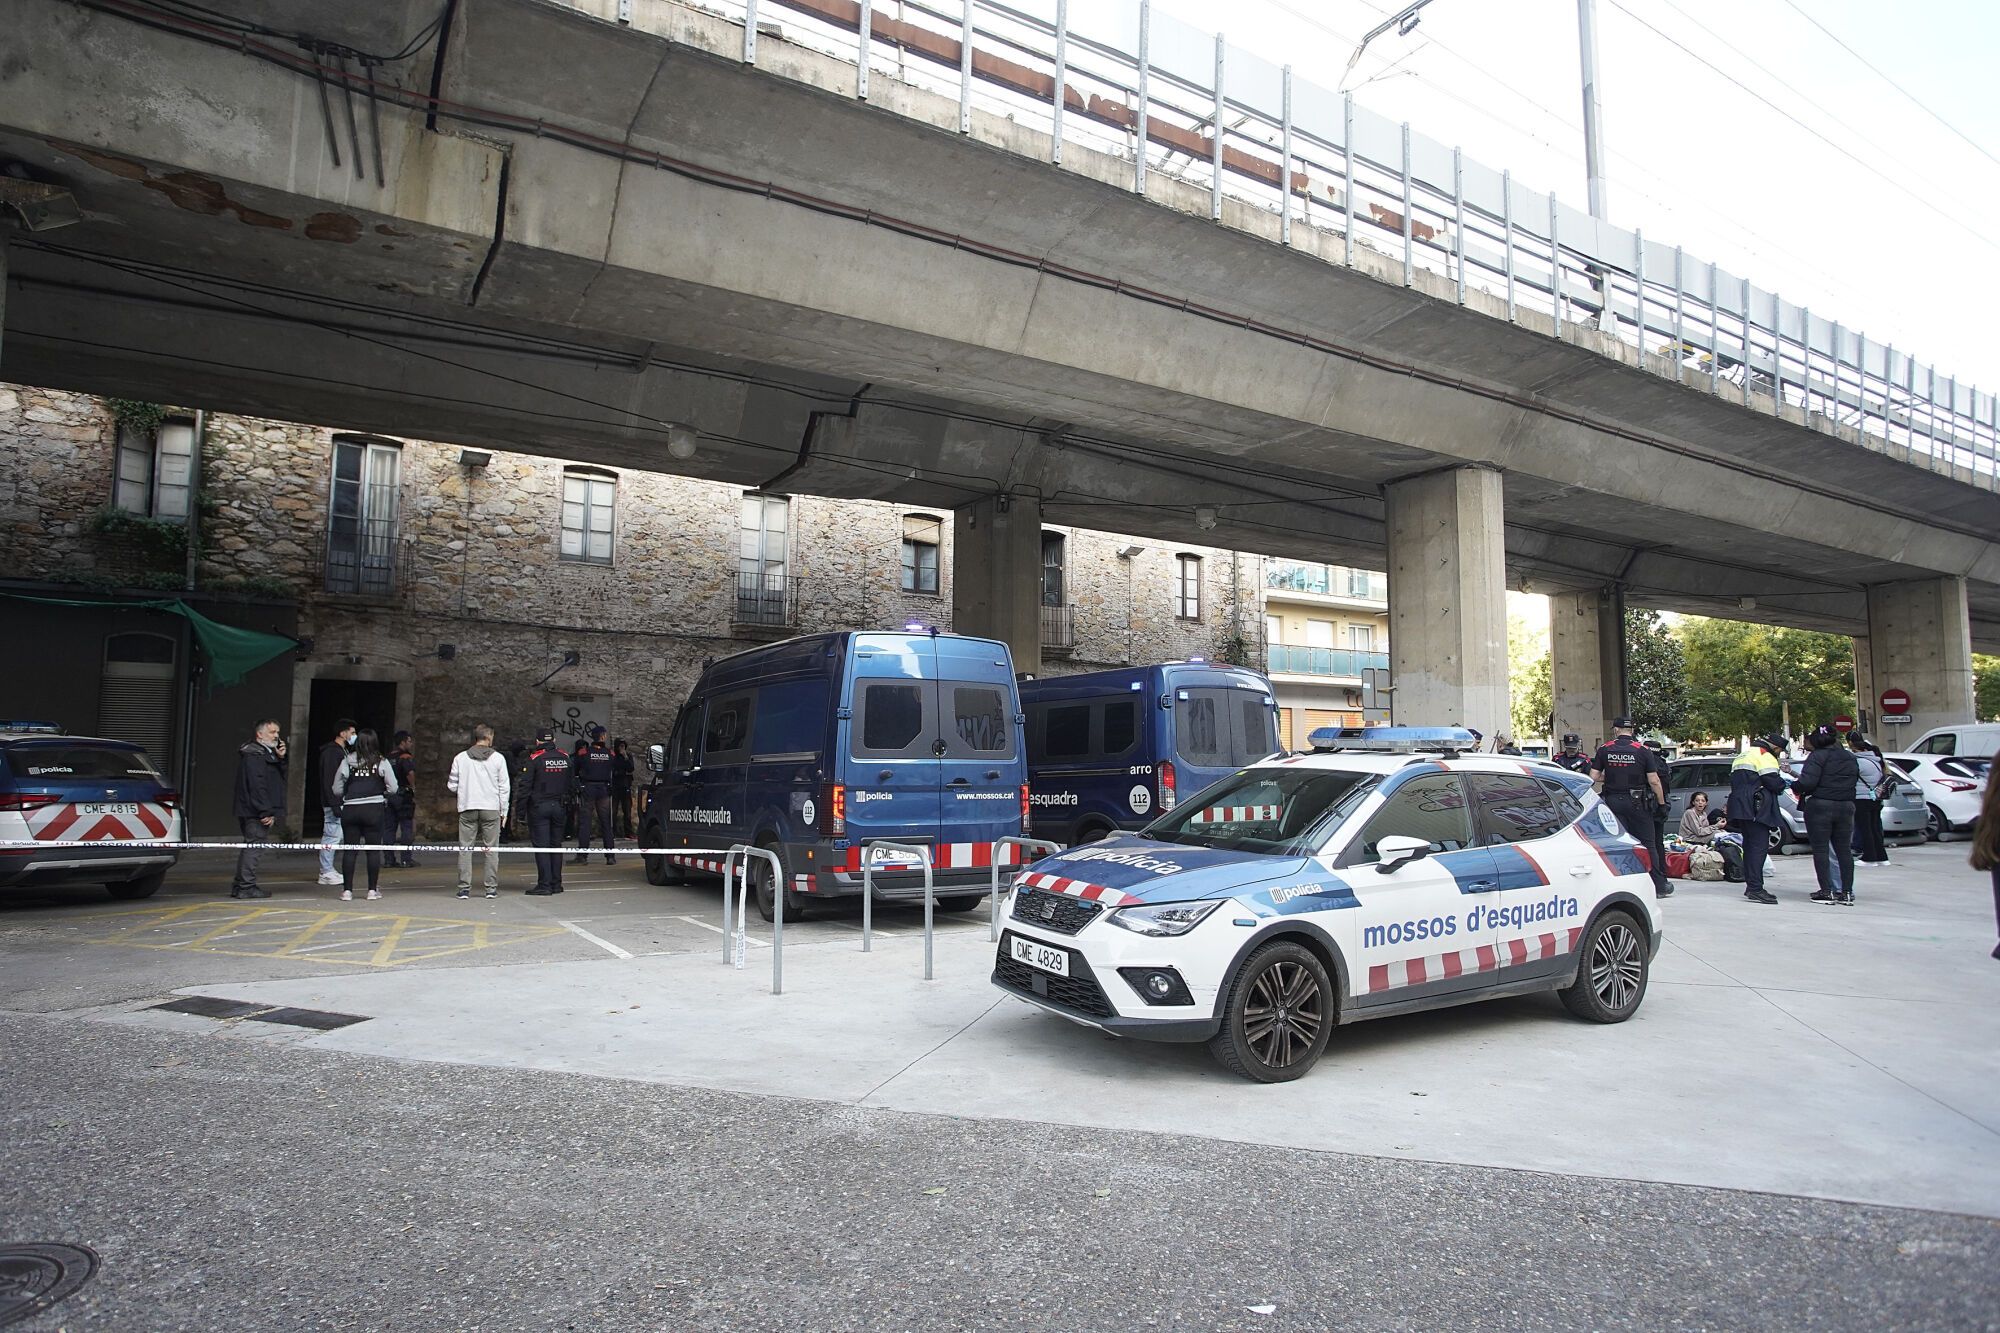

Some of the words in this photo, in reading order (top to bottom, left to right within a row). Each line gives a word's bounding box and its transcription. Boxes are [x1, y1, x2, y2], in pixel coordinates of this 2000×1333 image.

[40, 766, 73, 774] policia
[1130, 764, 1152, 775] arro
[866, 792, 892, 801] policia
[956, 791, 1014, 800] www.mossos.cat
[1029, 790, 1078, 808] esquadra
[1133, 793, 1148, 804] 112
[84, 804, 106, 814] CME
[110, 804, 137, 814] 4815
[804, 806, 813, 815] 112
[669, 809, 692, 822] mossos
[693, 806, 732, 827] d'esquadra
[1601, 812, 1615, 823] 112
[875, 849, 893, 859] CME
[1083, 849, 1183, 875] policia
[1283, 881, 1323, 901] policia
[1364, 914, 1457, 949] mossos
[1466, 894, 1578, 934] d'esquadra
[1016, 941, 1033, 962] CME
[1037, 948, 1063, 971] 4829
